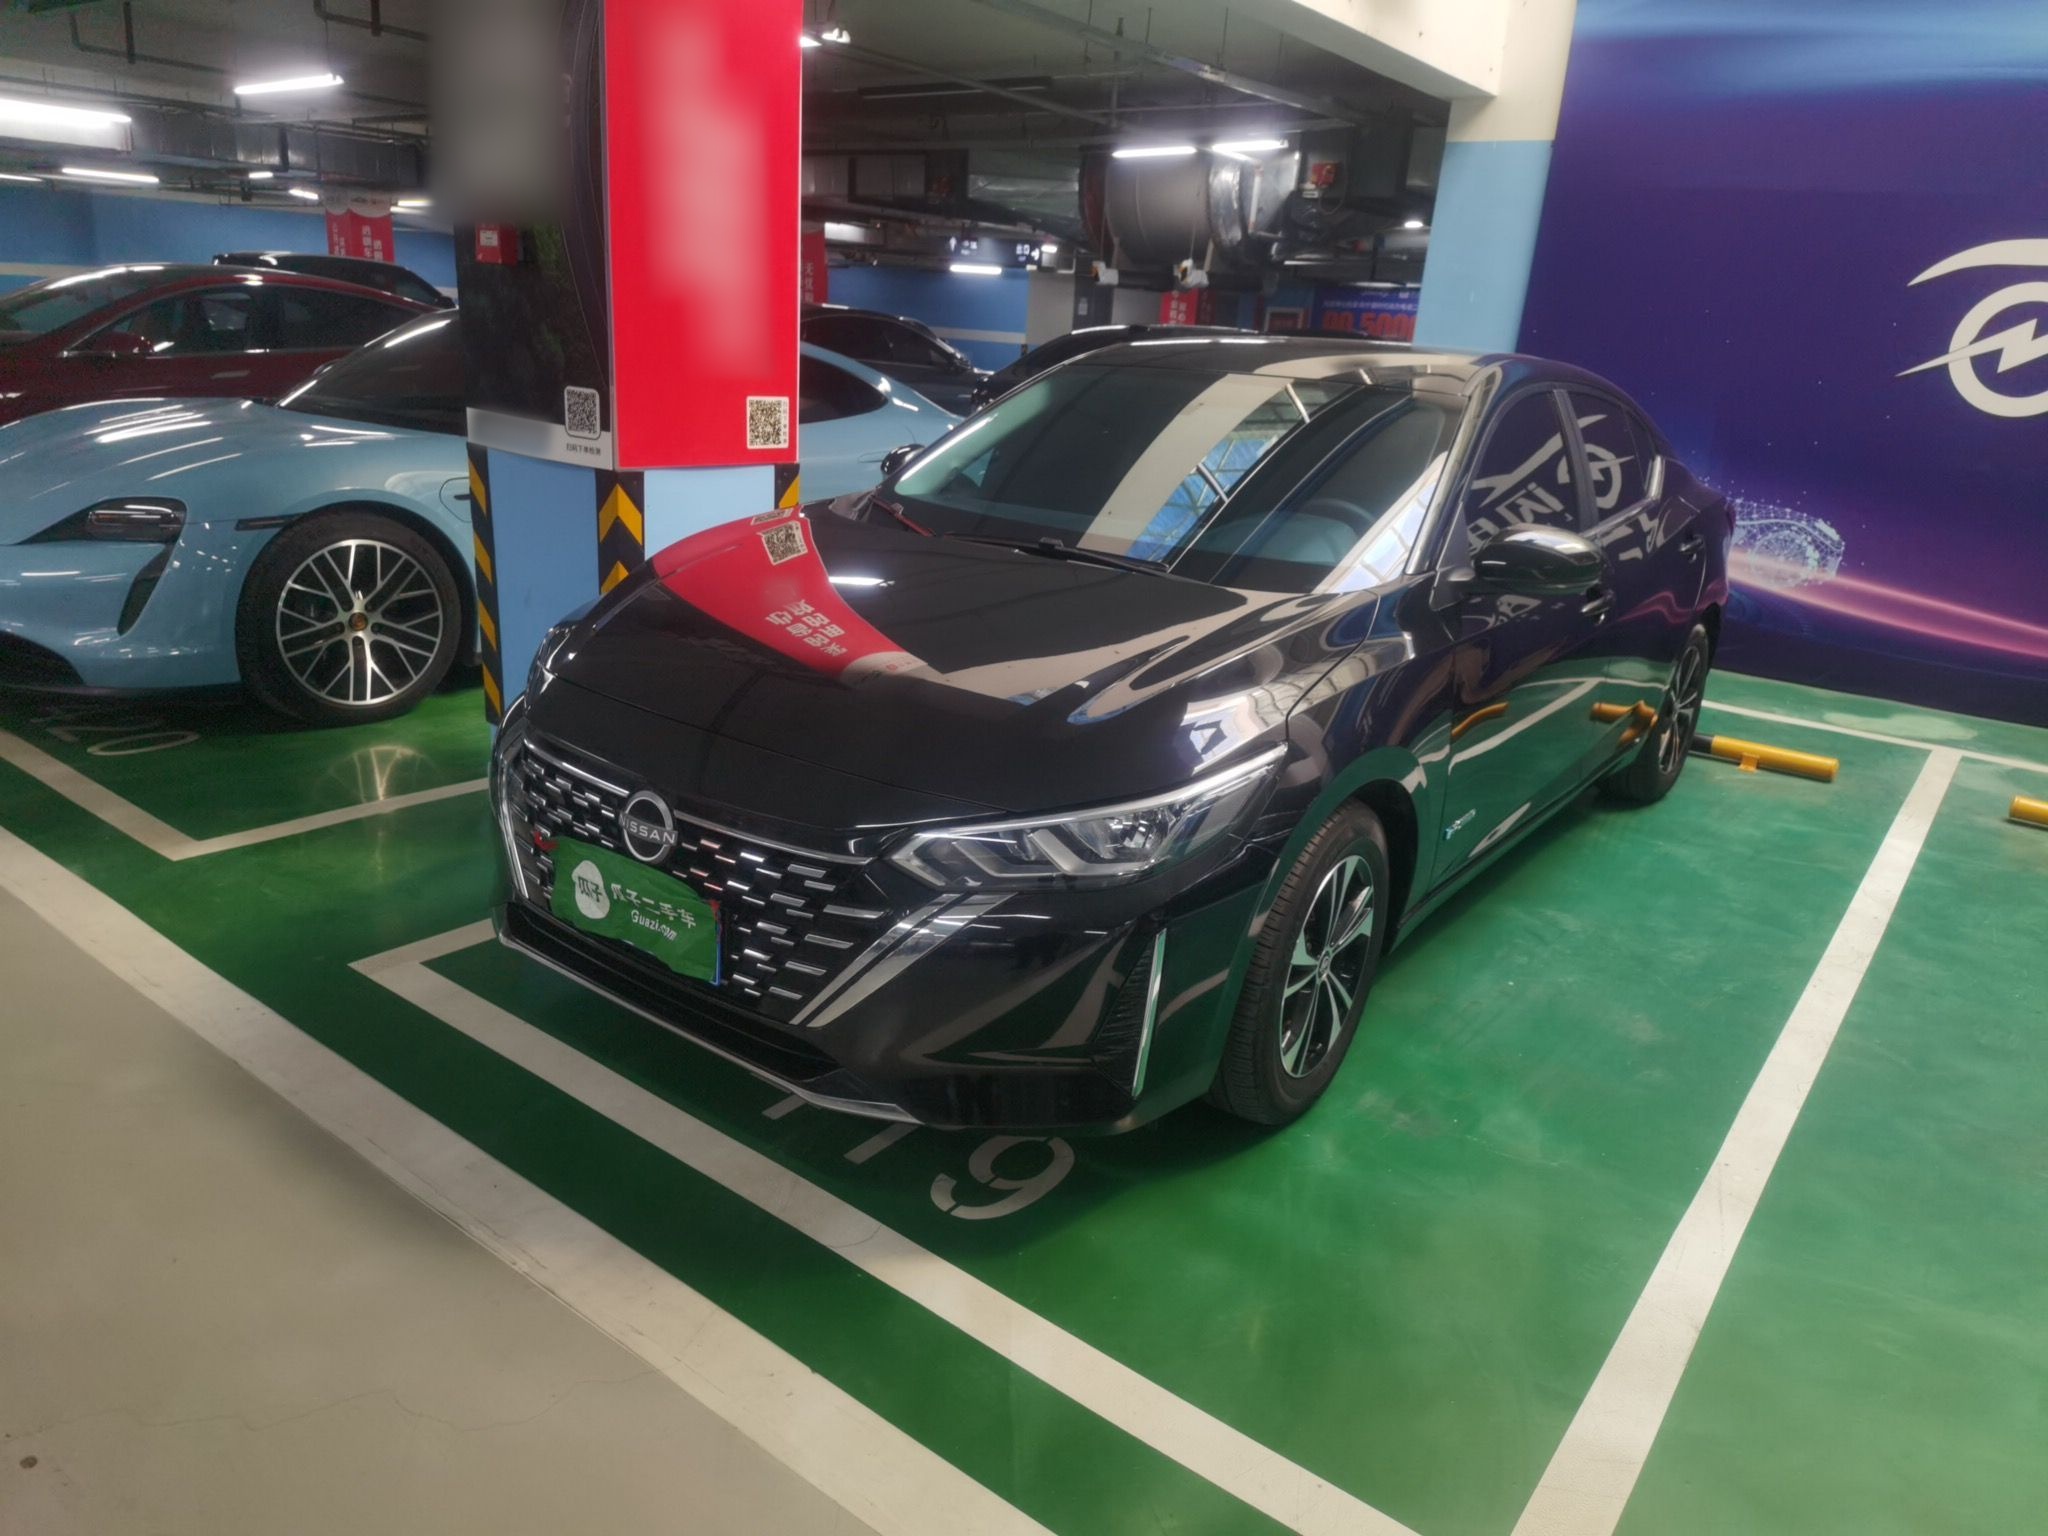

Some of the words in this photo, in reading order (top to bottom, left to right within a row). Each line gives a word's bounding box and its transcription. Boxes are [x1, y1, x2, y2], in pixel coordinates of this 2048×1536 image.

[619, 813, 676, 844] NISSAN
[578, 876, 603, 903] 瓜子
[611, 883, 697, 929] 瓜子二手车
[630, 909, 678, 941] Guazi.com
